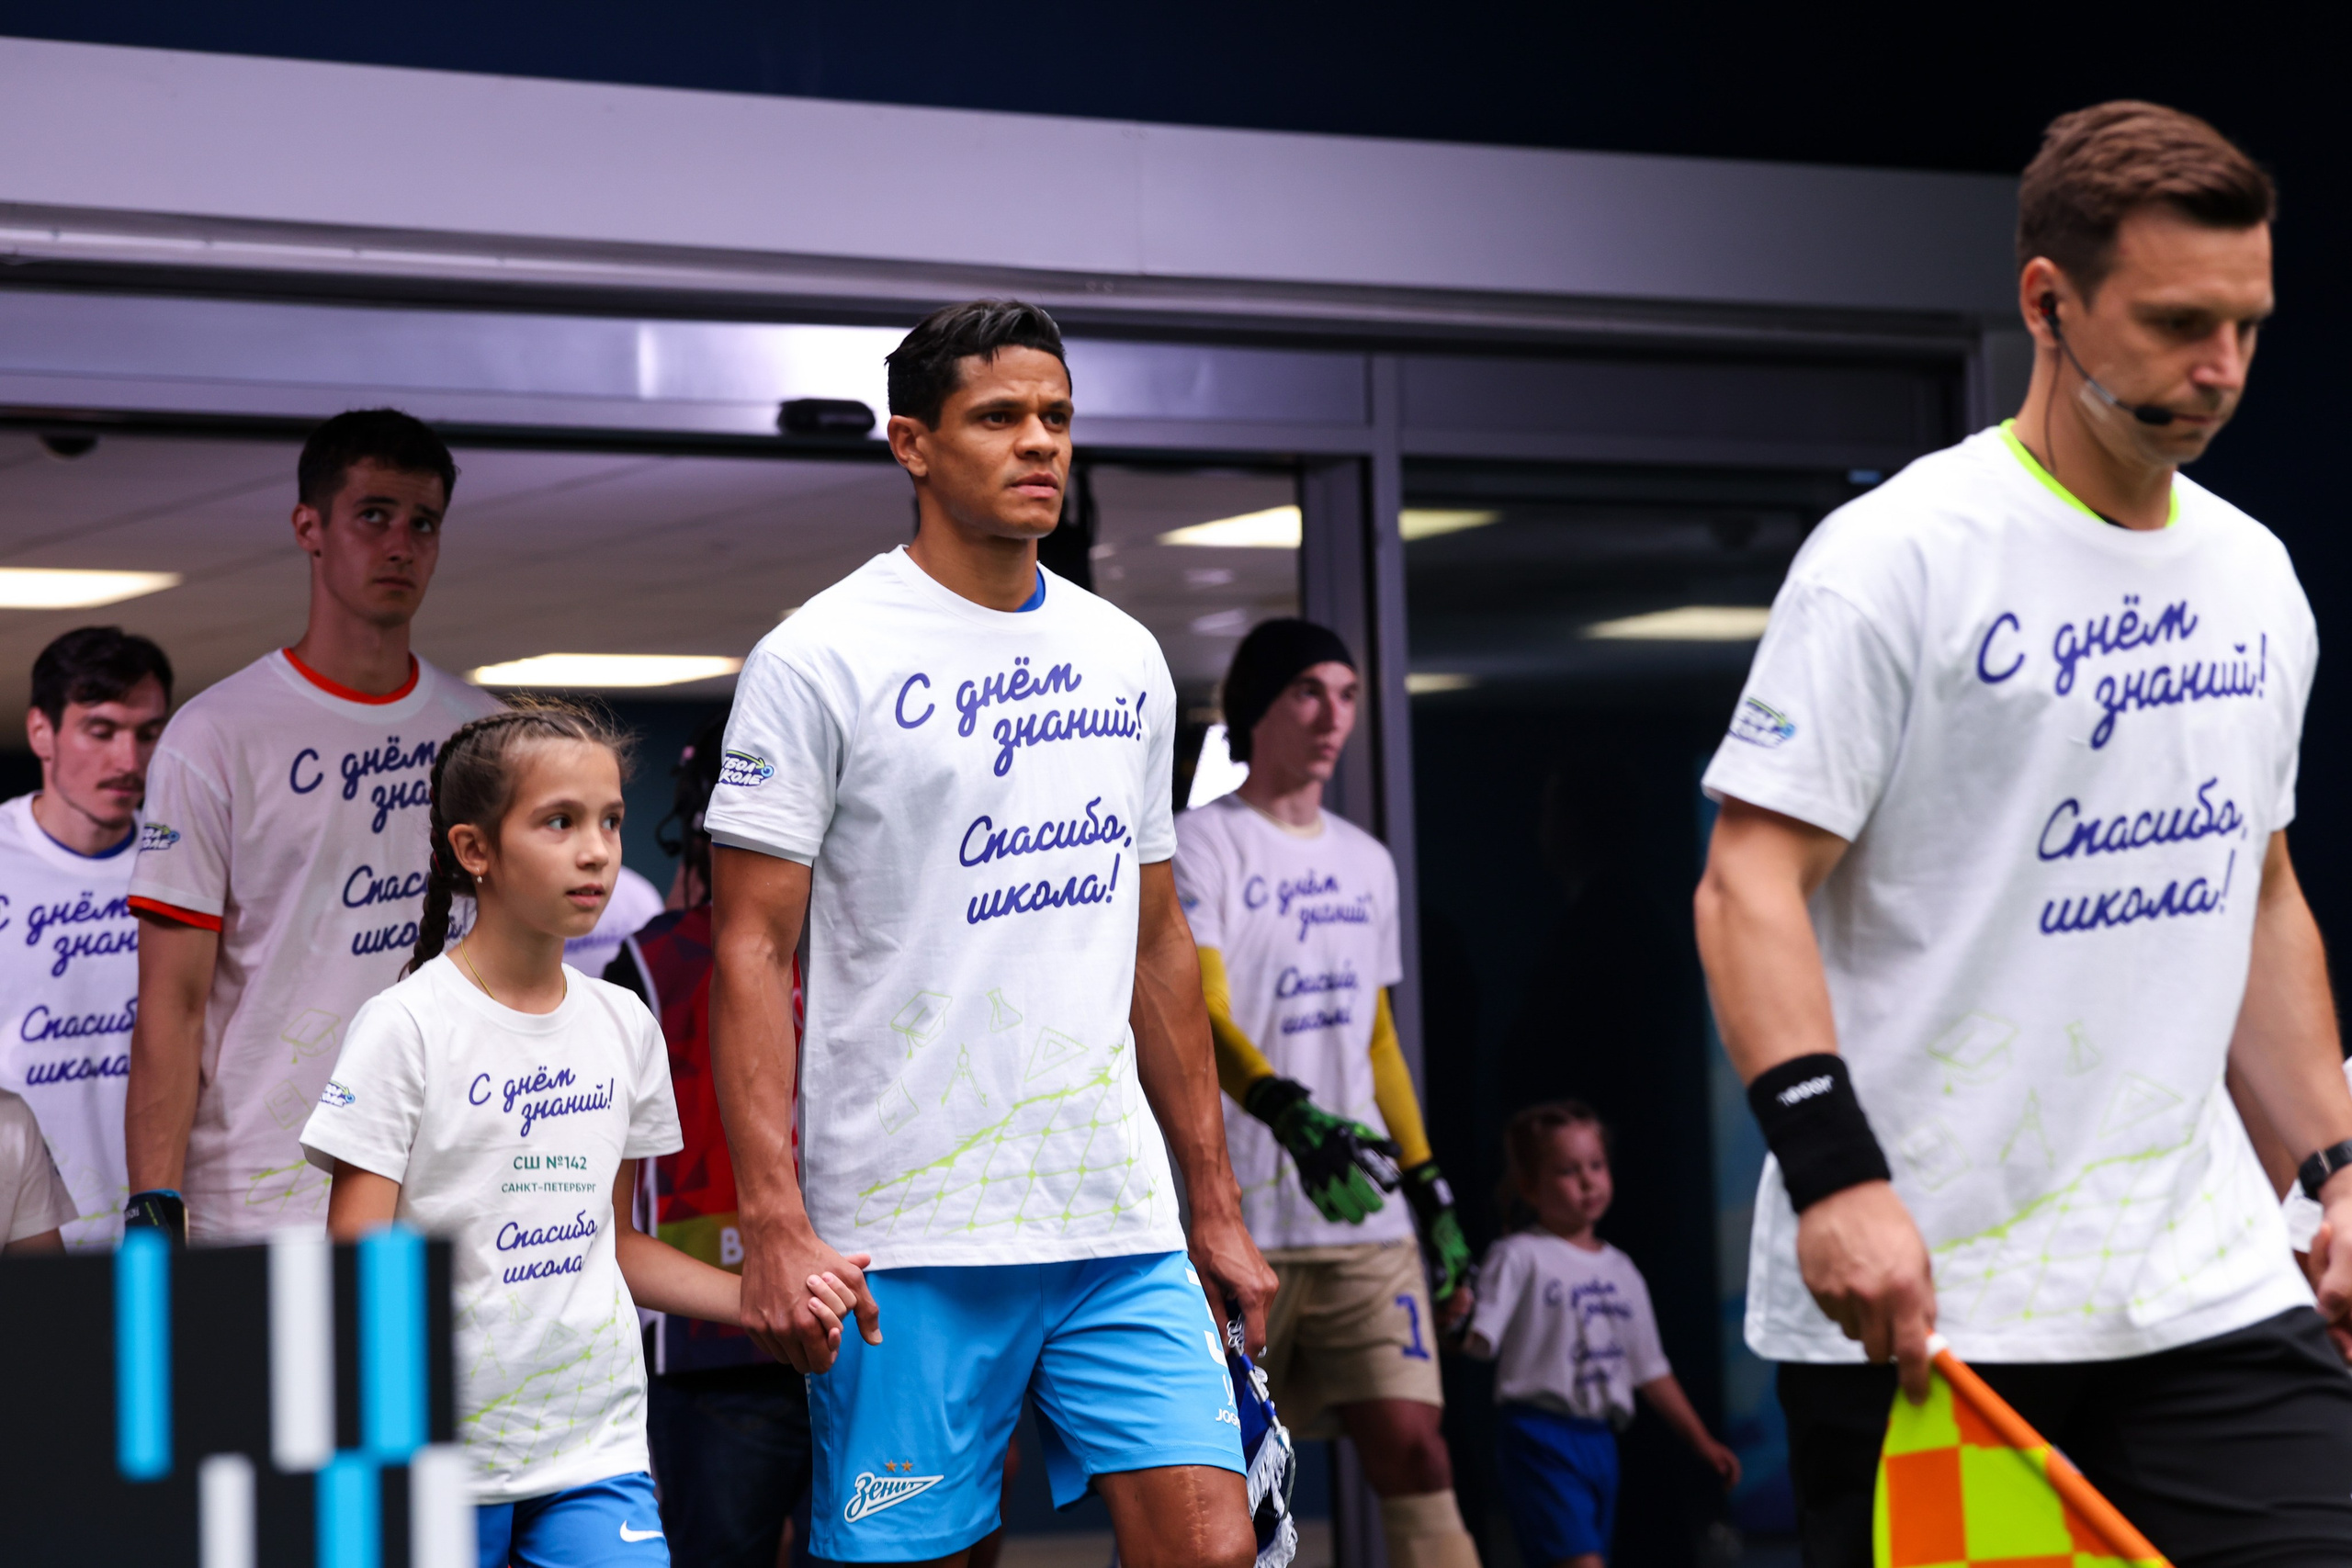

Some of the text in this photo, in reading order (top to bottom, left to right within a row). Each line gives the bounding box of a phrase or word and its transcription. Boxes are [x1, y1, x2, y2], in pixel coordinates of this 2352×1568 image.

[1977, 594, 2198, 696] С днём
[895, 657, 1082, 737] С днём
[2090, 633, 2267, 750] знаний!
[992, 691, 1148, 776] знаний!
[289, 748, 324, 795] С
[718, 768, 764, 785] КОЛЕ
[958, 795, 1133, 867] Спасибо,
[2037, 777, 2247, 862] Спасибо,
[966, 852, 1122, 925] школа!
[2040, 849, 2236, 936] школа!
[51, 930, 139, 977] знан
[21, 998, 138, 1043] Спасиб
[26, 1055, 130, 1086] школа
[469, 1066, 576, 1113] С днём
[520, 1077, 614, 1137] знаний!
[501, 1181, 597, 1194] САНКТ-ПЕТЕРБУРГ
[513, 1156, 541, 1170] СШ
[503, 1253, 586, 1284] школа
[1395, 1293, 1430, 1362] 1
